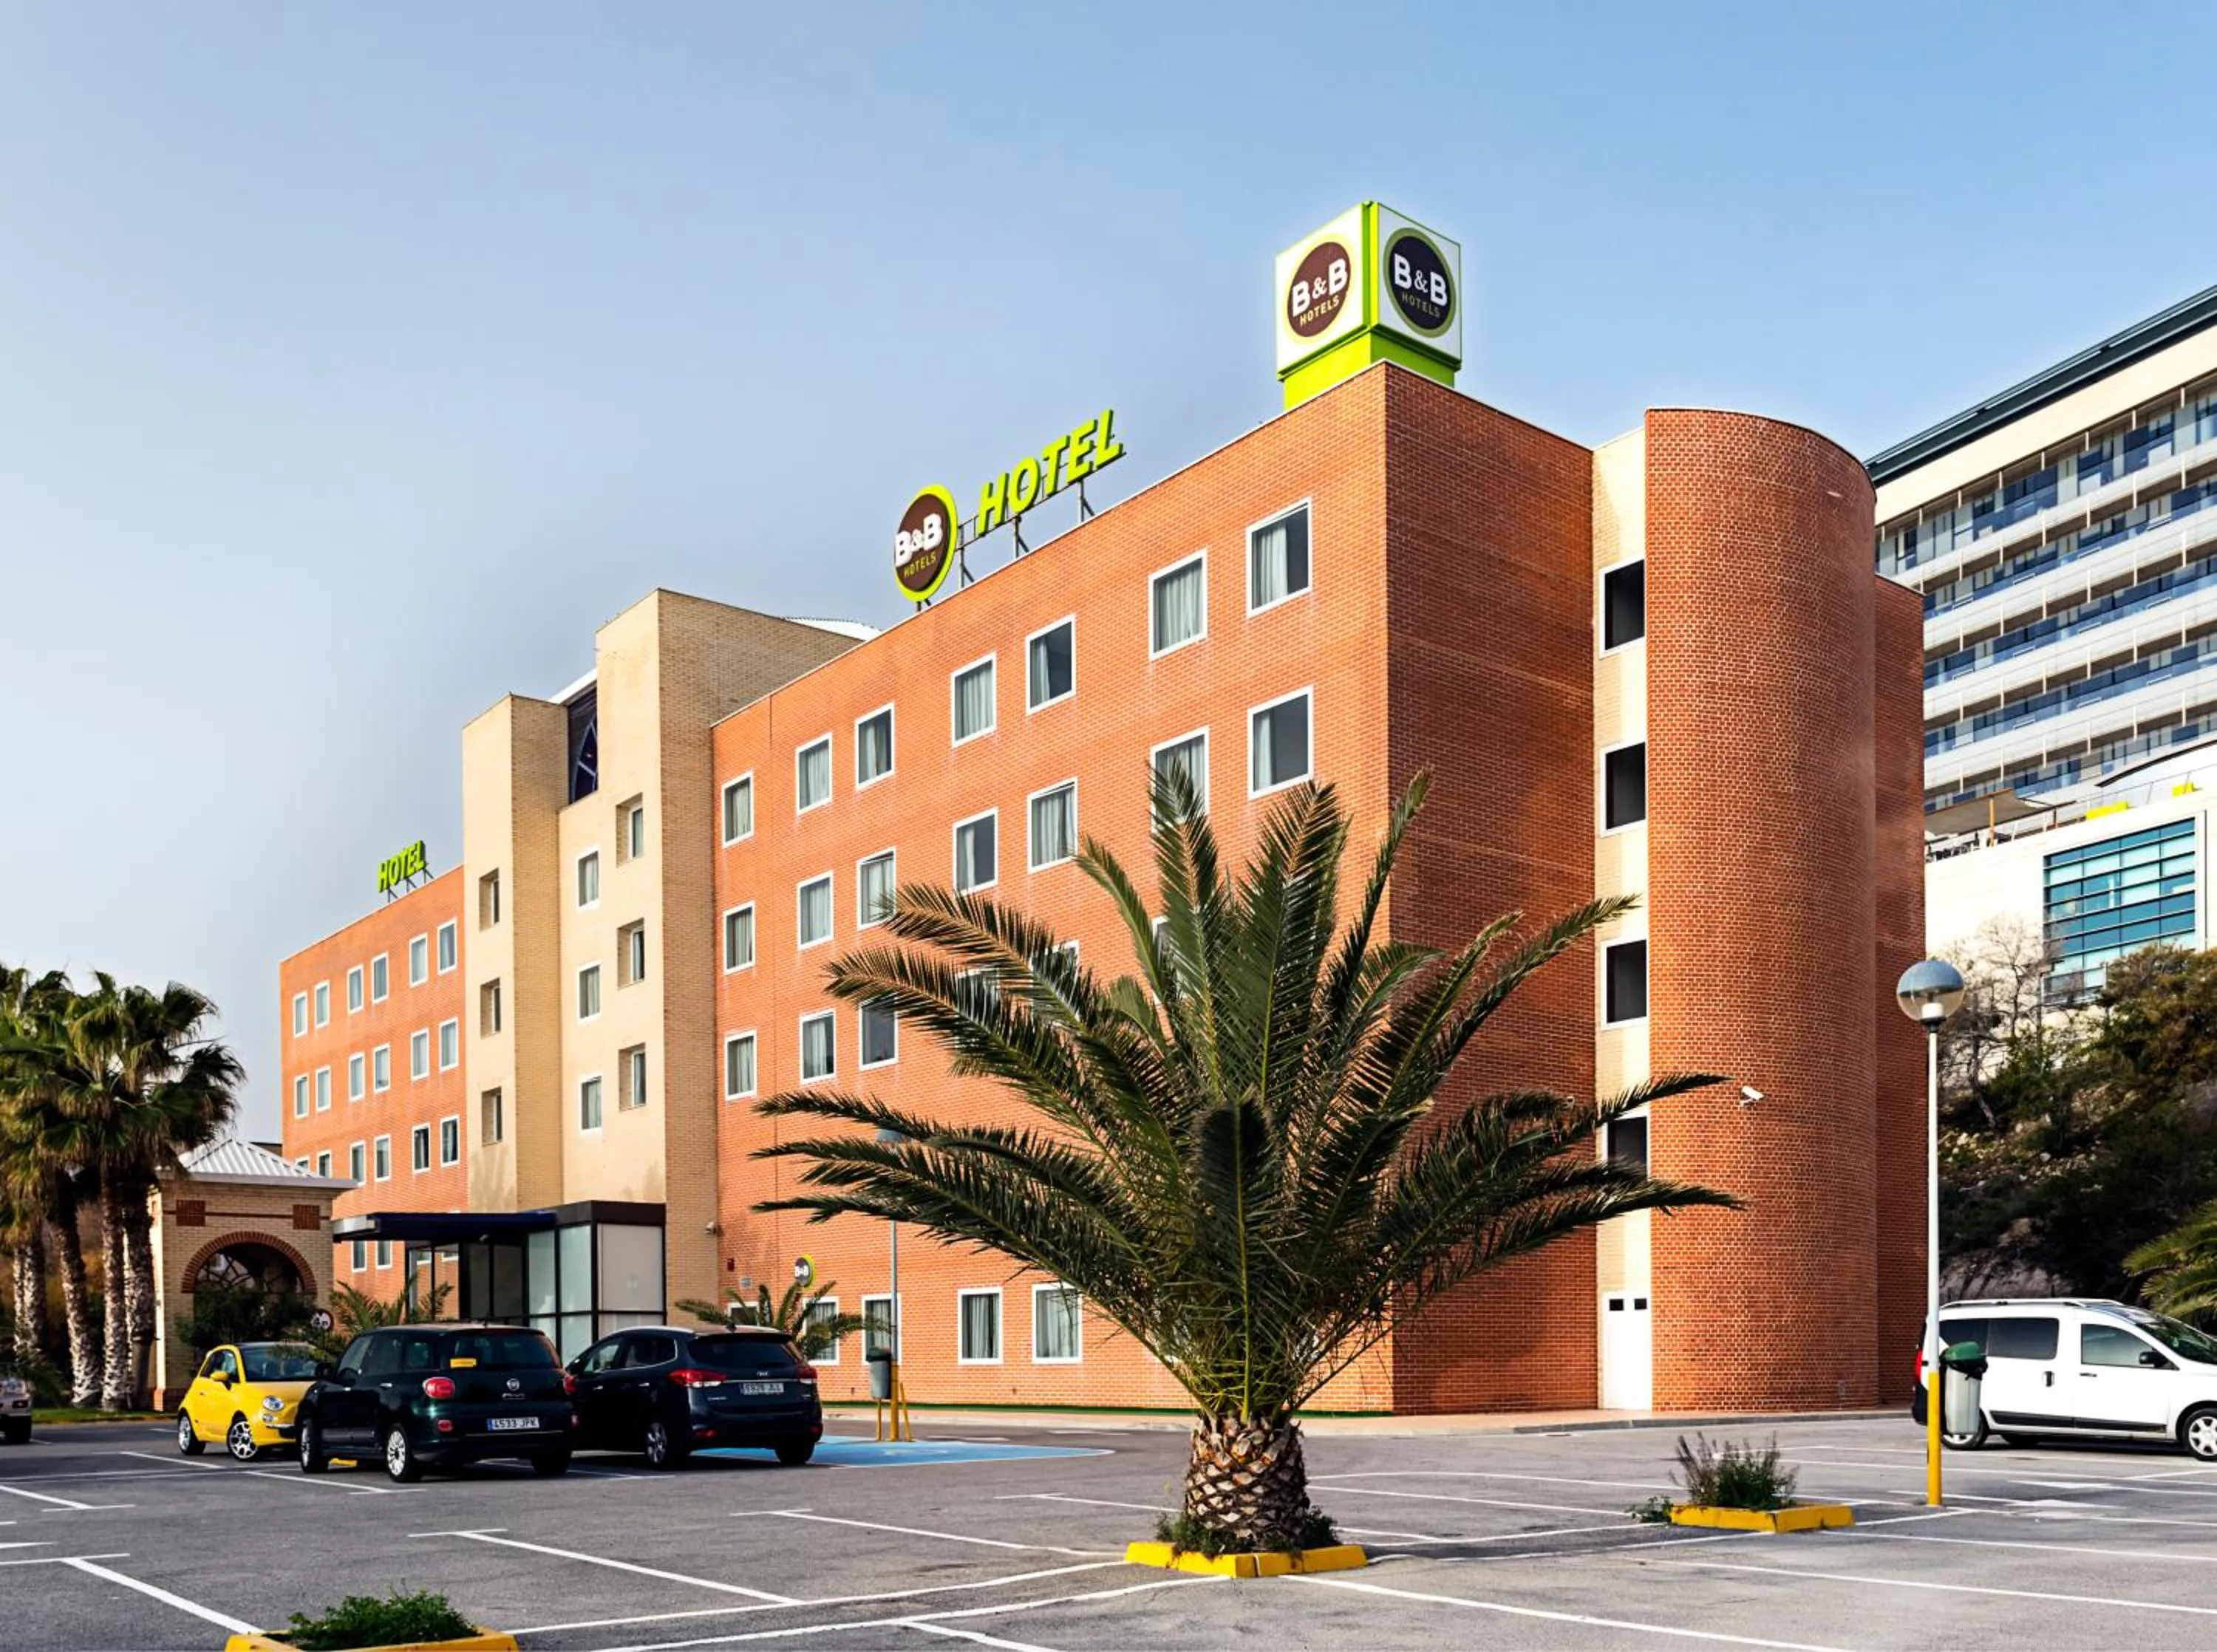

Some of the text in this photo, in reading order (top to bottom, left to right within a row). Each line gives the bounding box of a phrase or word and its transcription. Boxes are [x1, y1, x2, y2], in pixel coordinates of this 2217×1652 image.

[1292, 259, 1348, 317] B&B
[1394, 253, 1448, 307] B&B
[1402, 292, 1440, 318] HOTELS
[1300, 295, 1340, 327] HOTELS
[977, 409, 1125, 537] HOTEL
[895, 513, 943, 567] B&B
[903, 552, 936, 577] HOTELS
[378, 839, 426, 892] HOTEL
